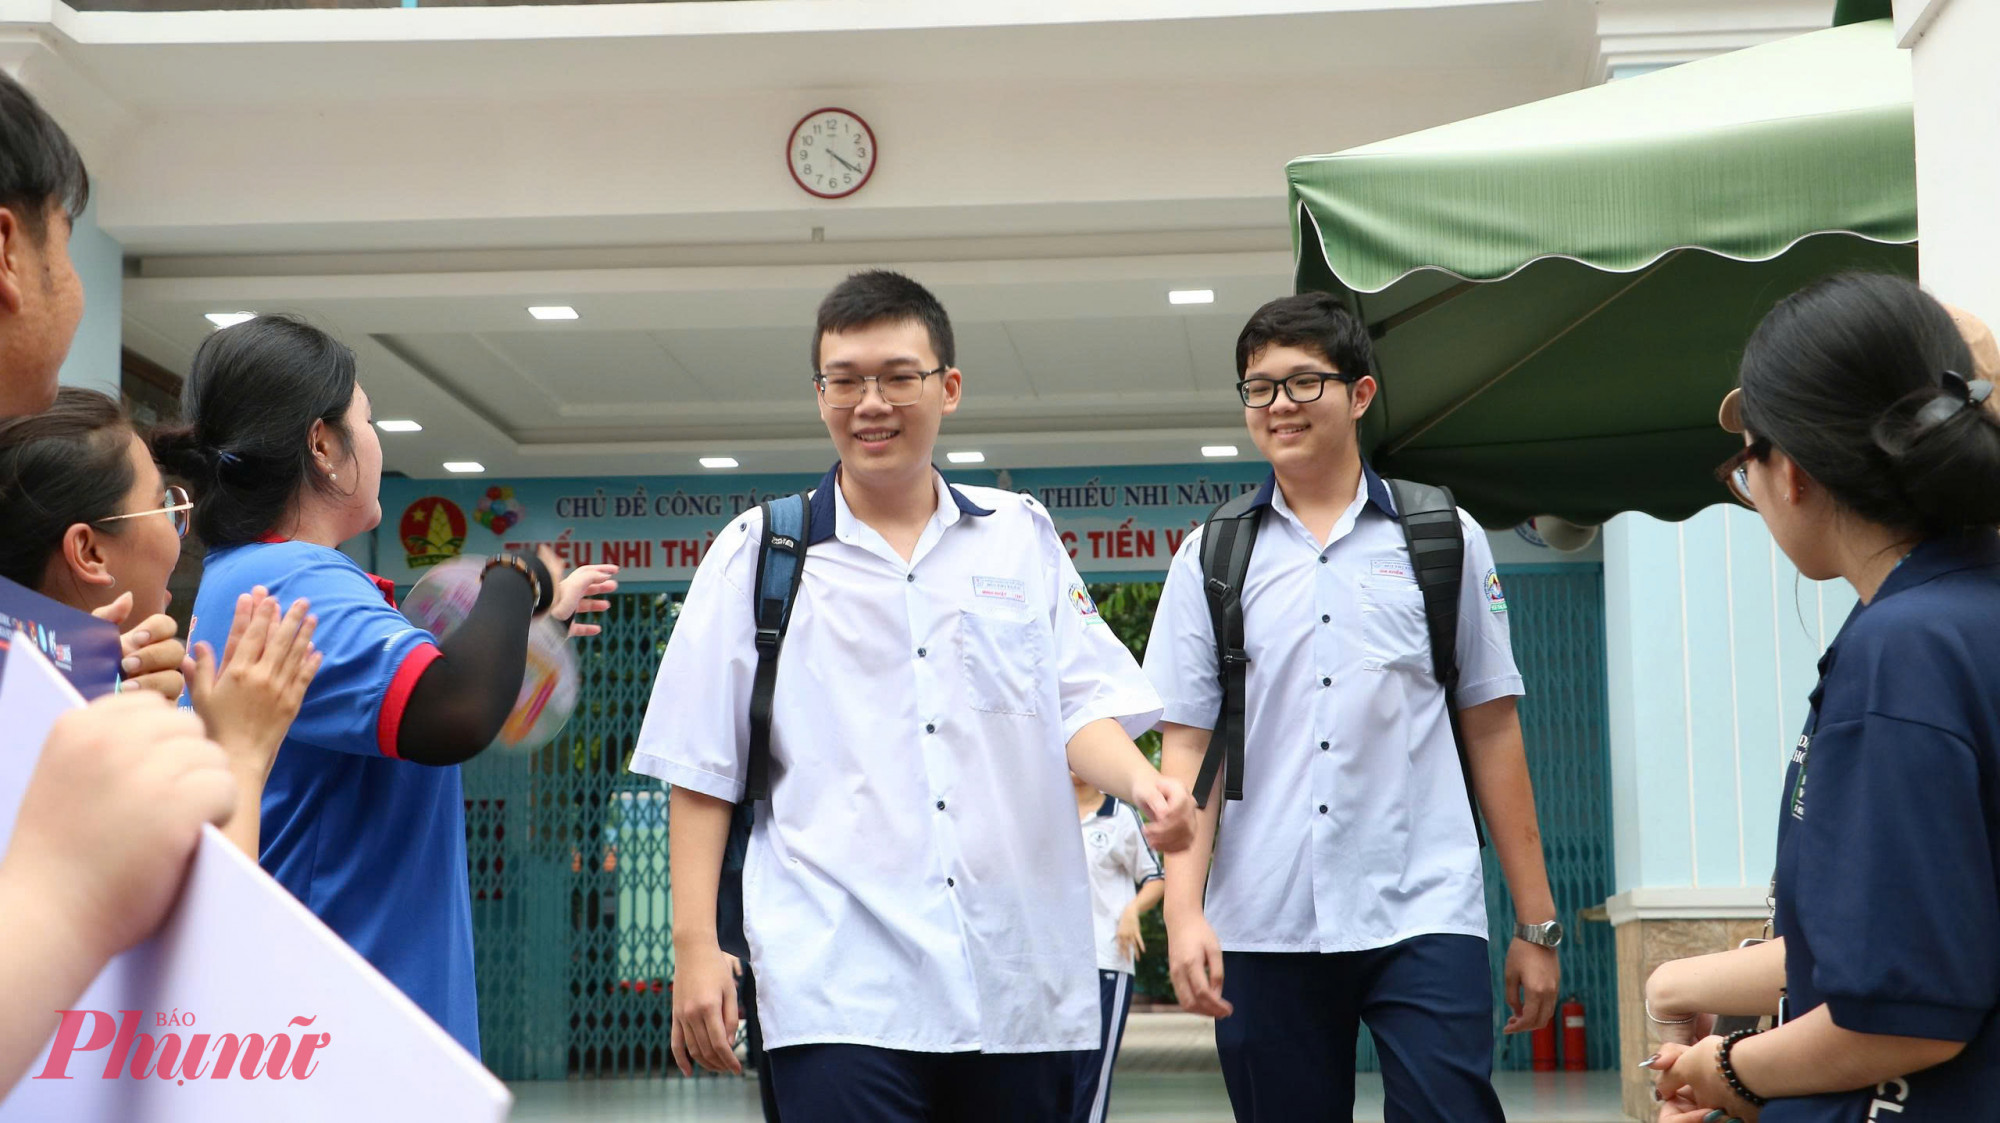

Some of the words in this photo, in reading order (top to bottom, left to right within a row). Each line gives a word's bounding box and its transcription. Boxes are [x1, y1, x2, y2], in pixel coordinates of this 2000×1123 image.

[813, 124, 822, 134] 11
[825, 119, 838, 130] 12
[844, 123, 849, 133] 1
[802, 135, 813, 146] 10
[853, 133, 862, 144] 2
[800, 150, 809, 160] 9
[857, 147, 866, 158] 3
[803, 163, 812, 175] 8
[815, 174, 824, 185] 7
[828, 178, 838, 189] 6
[843, 173, 852, 184] 5
[1040, 477, 1117, 508] THIẾU
[1124, 485, 1169, 506] NHI
[1177, 479, 1230, 505] NĂM
[556, 488, 607, 518] CHỦ
[614, 485, 647, 517] ĐỀ
[655, 489, 721, 517] CÔNG
[1087, 517, 1155, 558] TIẾN
[602, 540, 651, 568] NHI
[1867, 1077, 1910, 1123] CL
